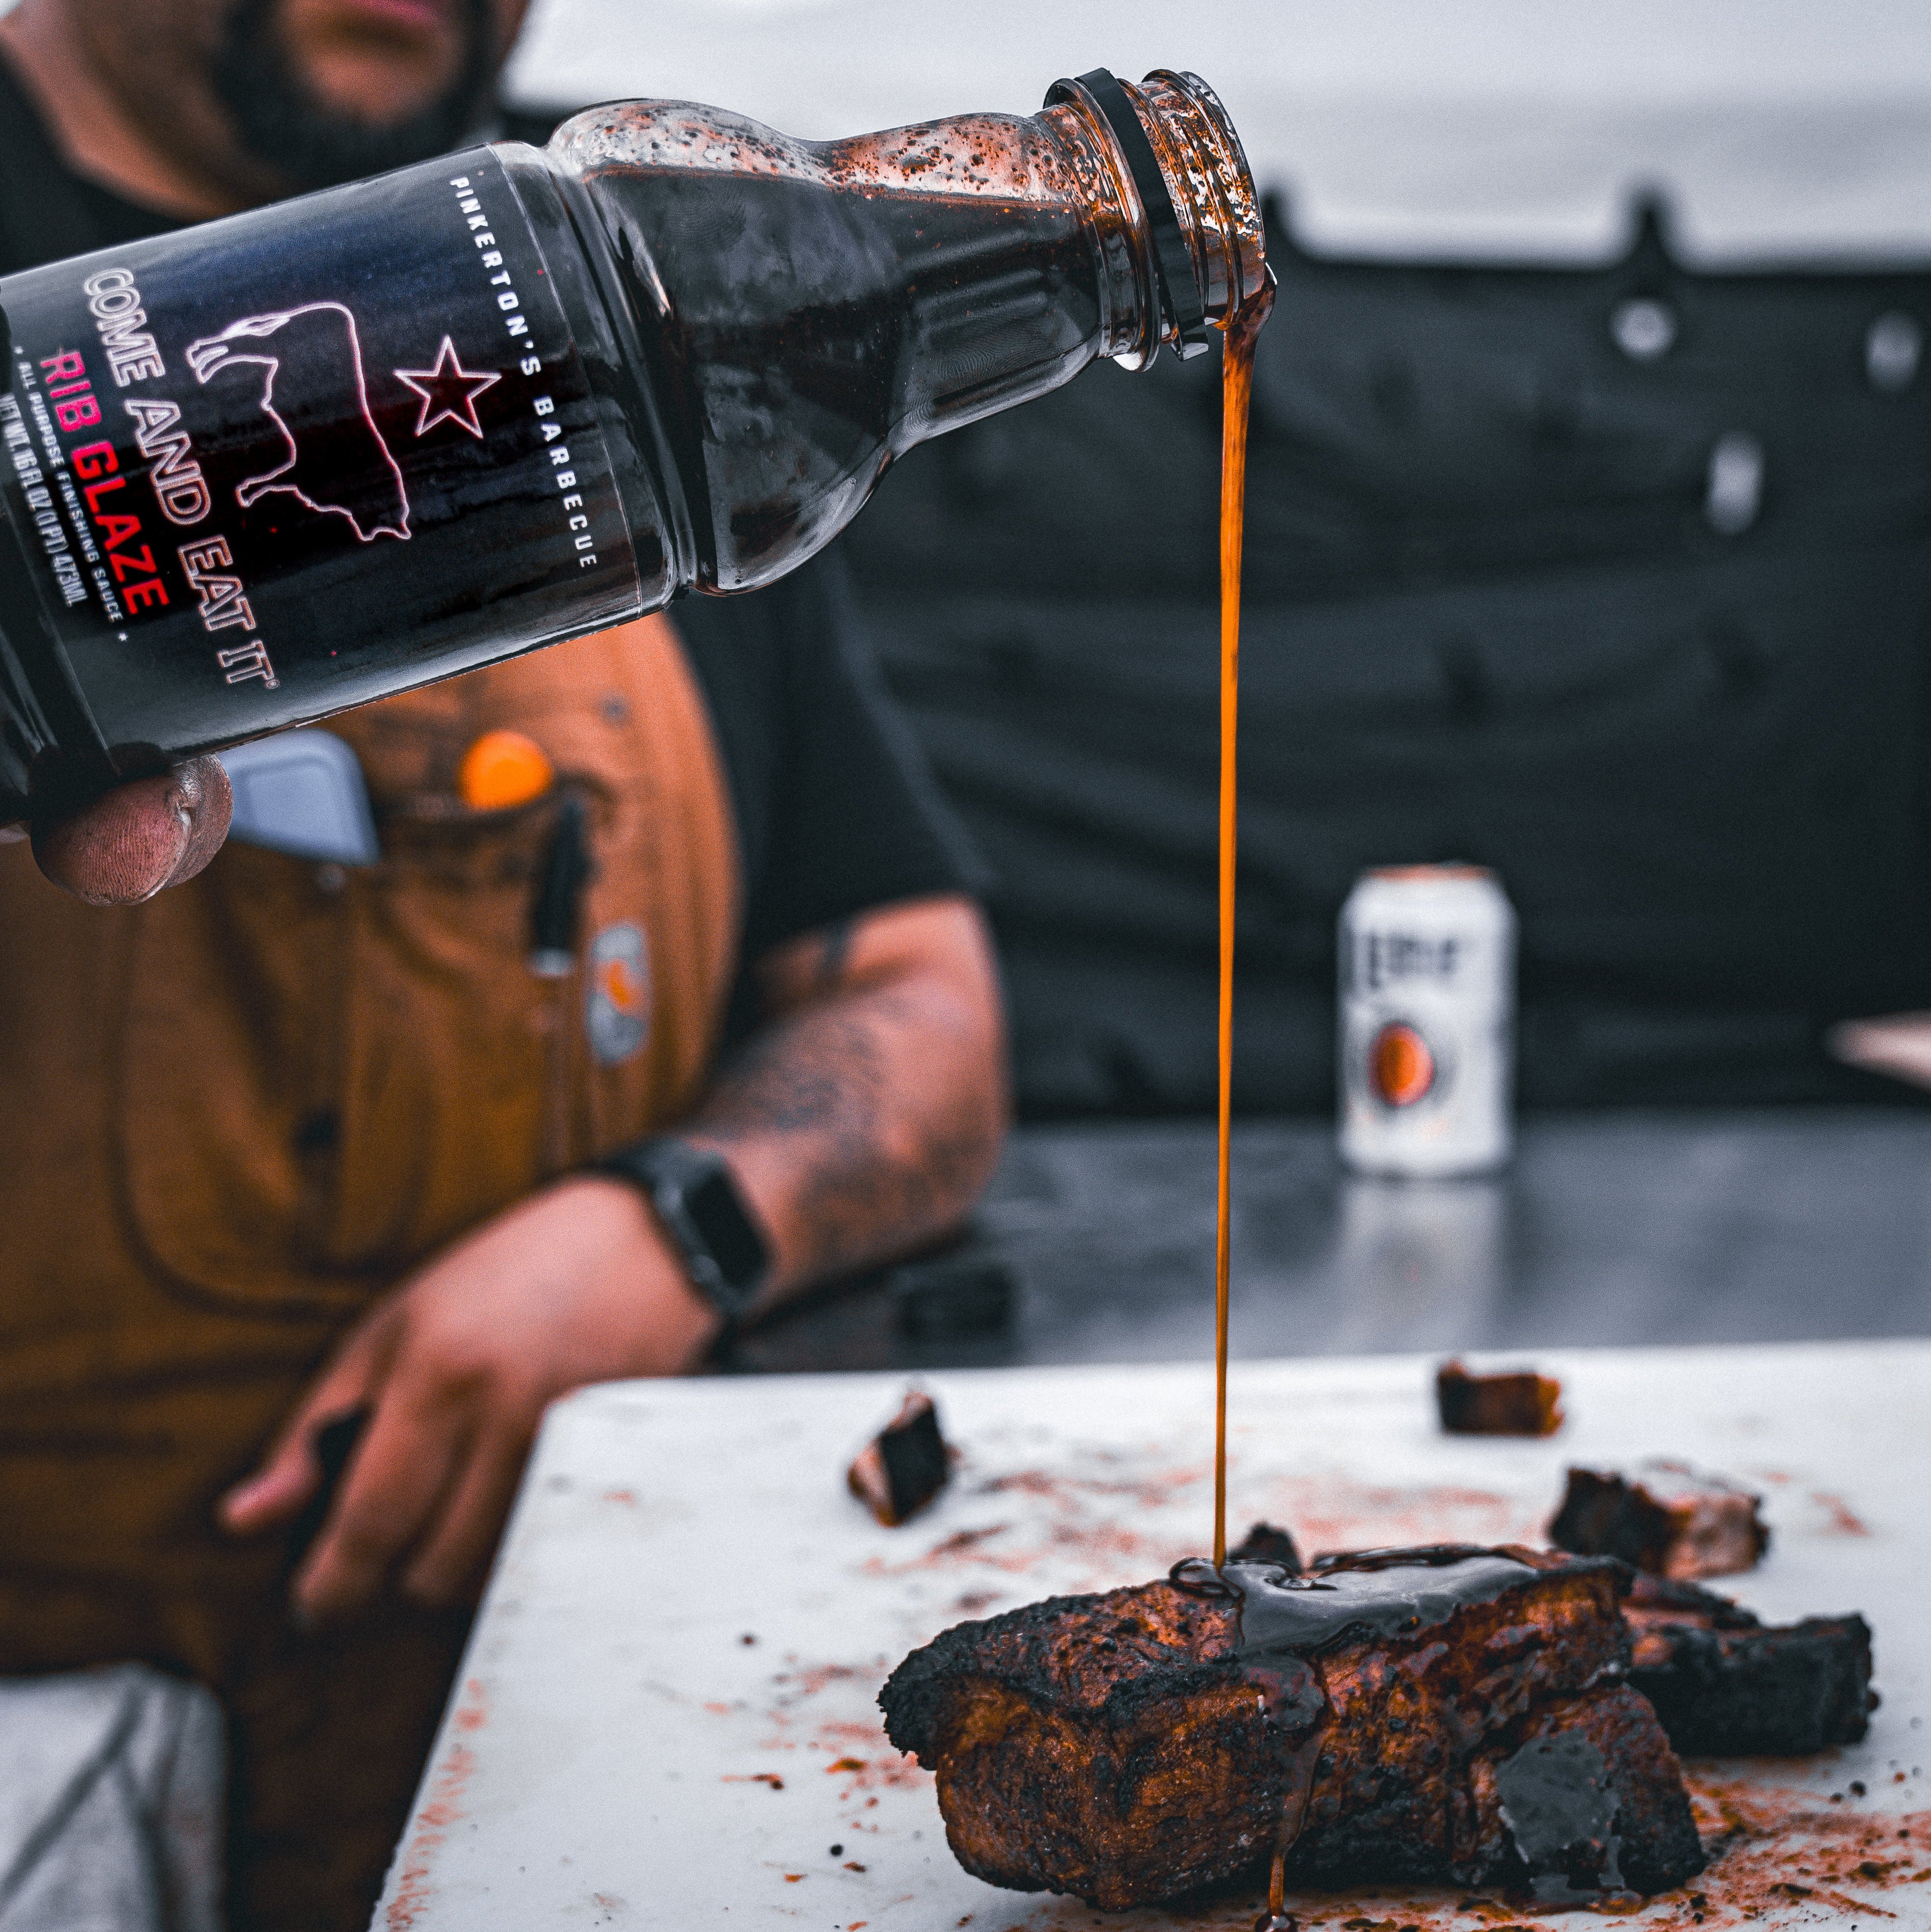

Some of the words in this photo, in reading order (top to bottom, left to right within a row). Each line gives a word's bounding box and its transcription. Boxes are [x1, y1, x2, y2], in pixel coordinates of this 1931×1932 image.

[84, 267, 166, 388] COME
[450, 177, 542, 376] PINKERTON'S
[534, 396, 597, 567] BARBECUE
[18, 362, 36, 390] ALL
[29, 392, 65, 467] PURPOSE
[55, 471, 100, 563] FINISHING
[91, 566, 123, 623] SAUCE
[40, 349, 102, 432] RIB
[71, 440, 170, 615] GLAZE
[124, 398, 211, 526] AND
[177, 534, 256, 631] EAT
